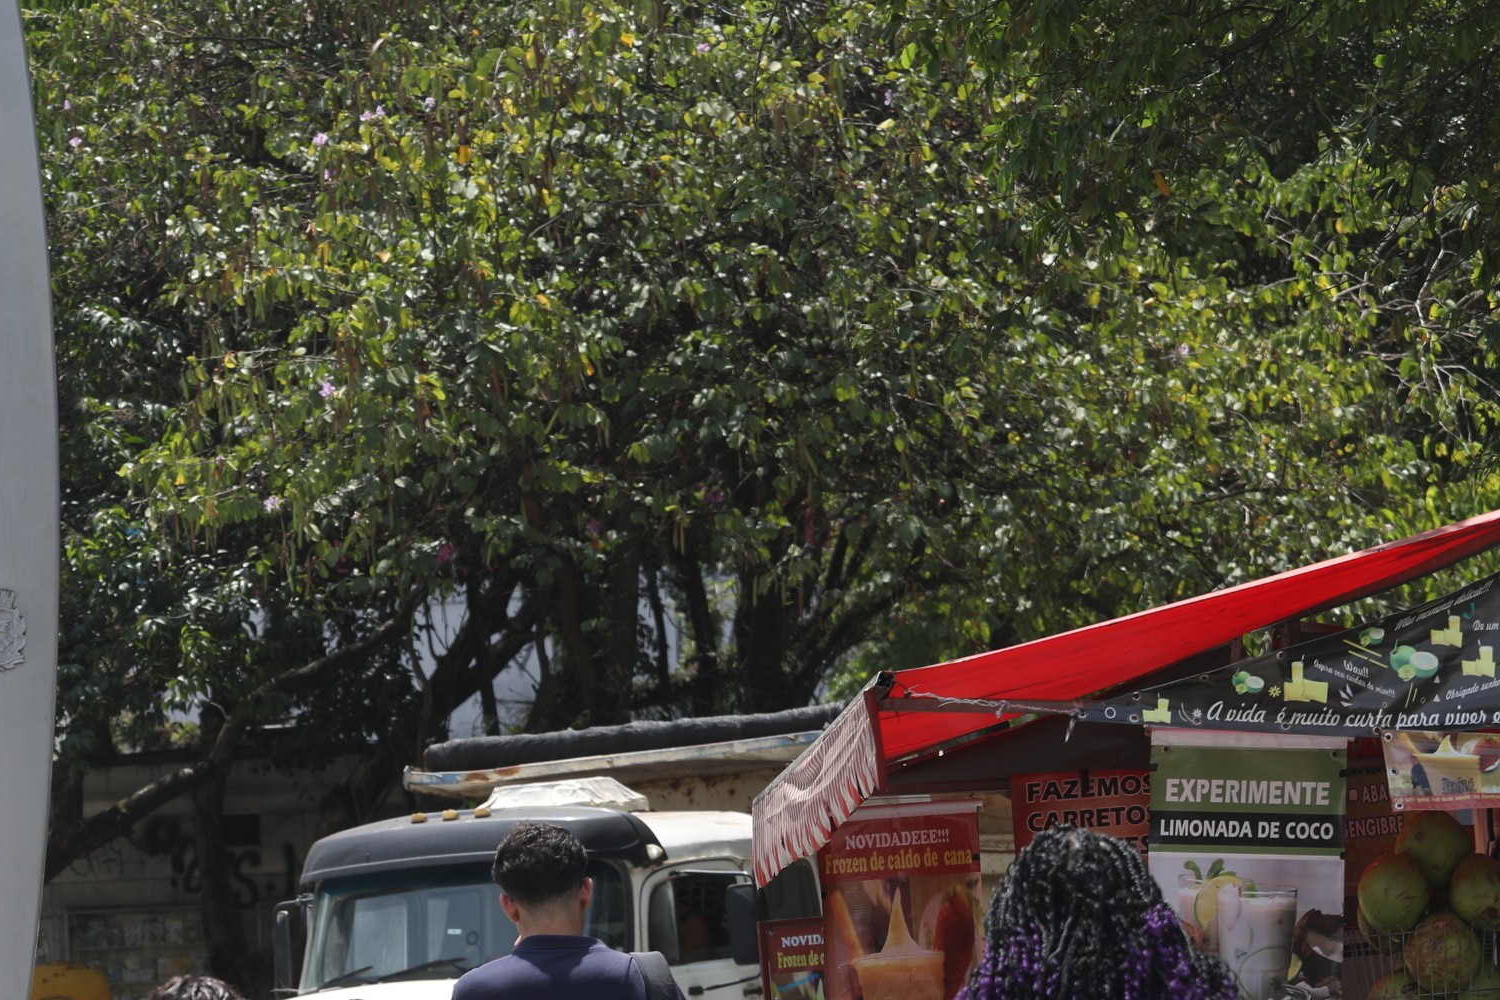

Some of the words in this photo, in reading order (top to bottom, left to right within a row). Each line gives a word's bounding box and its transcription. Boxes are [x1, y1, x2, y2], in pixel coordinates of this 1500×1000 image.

[1207, 701, 1224, 720] A
[1225, 702, 1266, 723] vida
[1274, 706, 1286, 724] é
[1290, 706, 1340, 726] muito
[1344, 708, 1392, 728] curta
[1395, 712, 1440, 730] para
[1444, 705, 1486, 726] viver
[1165, 778, 1330, 806] EXPERIMENTE
[1028, 806, 1150, 831] CARRETO
[1160, 819, 1251, 838] LIMONADA
[1258, 821, 1280, 839] DE
[1285, 822, 1334, 840] COCO
[1345, 815, 1403, 838] ENGIBRE
[845, 829, 949, 850] NOVIDADEEE!!!
[825, 853, 868, 875] Frozen
[870, 851, 884, 871] de
[888, 850, 920, 870] caldo
[924, 847, 938, 867] de
[944, 849, 972, 866] cana
[781, 934, 824, 948] NOVID
[777, 951, 807, 968] Frozen
[808, 950, 818, 966] de
